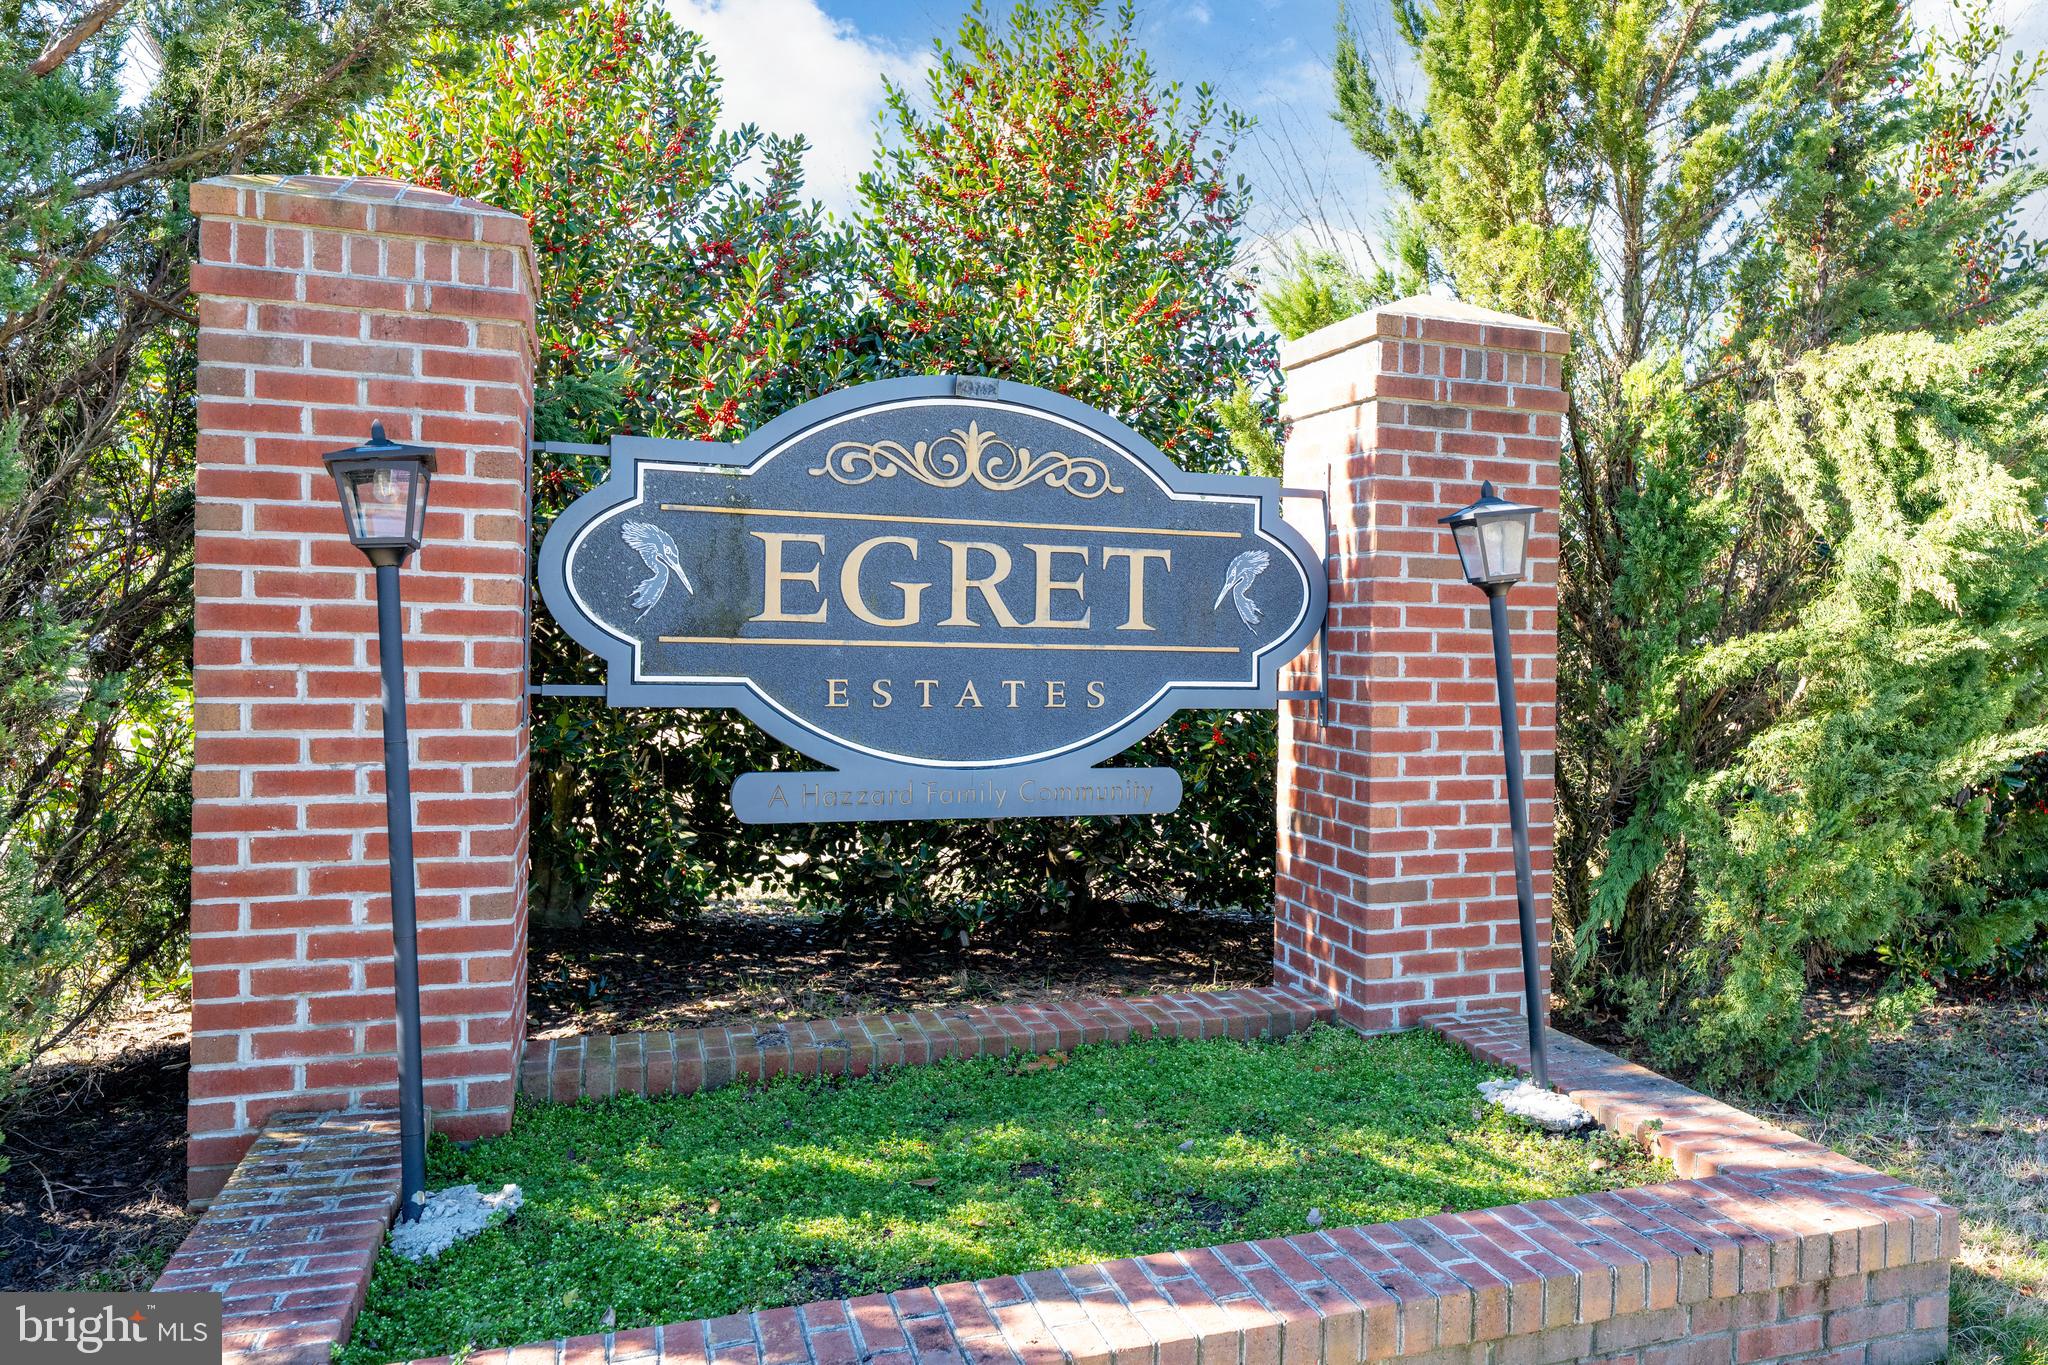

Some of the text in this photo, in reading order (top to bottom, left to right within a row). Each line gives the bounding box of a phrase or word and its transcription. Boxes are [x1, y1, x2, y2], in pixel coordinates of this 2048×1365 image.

[748, 532, 1171, 631] EGRET
[826, 678, 1106, 708] ESTATES
[768, 778, 1154, 809] A Hazzard Family Community
